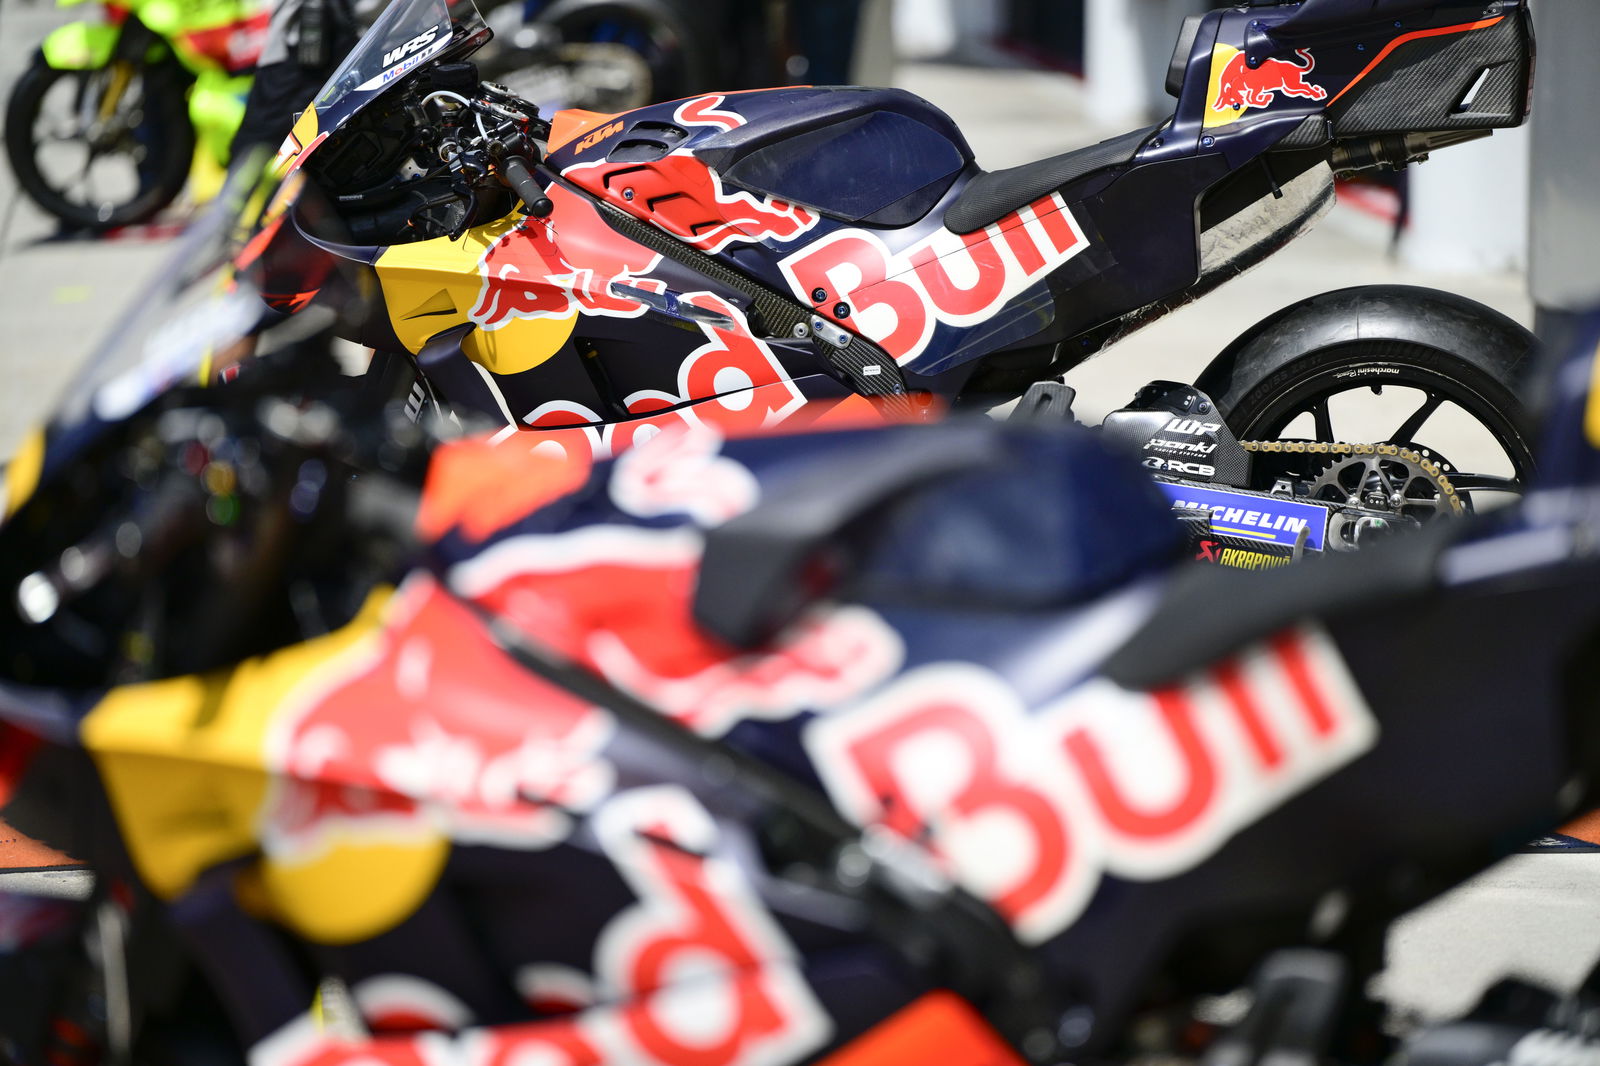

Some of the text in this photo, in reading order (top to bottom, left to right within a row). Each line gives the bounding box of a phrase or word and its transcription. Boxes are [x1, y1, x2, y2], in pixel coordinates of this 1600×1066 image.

[382, 25, 439, 68] WRS
[382, 56, 419, 83] Mobil
[574, 120, 624, 155] KTM
[788, 190, 1080, 364] Bull
[1357, 367, 1400, 376] marchesini
[1164, 418, 1221, 436] WP
[1167, 459, 1216, 477] RCB
[842, 625, 1345, 926] Bull
